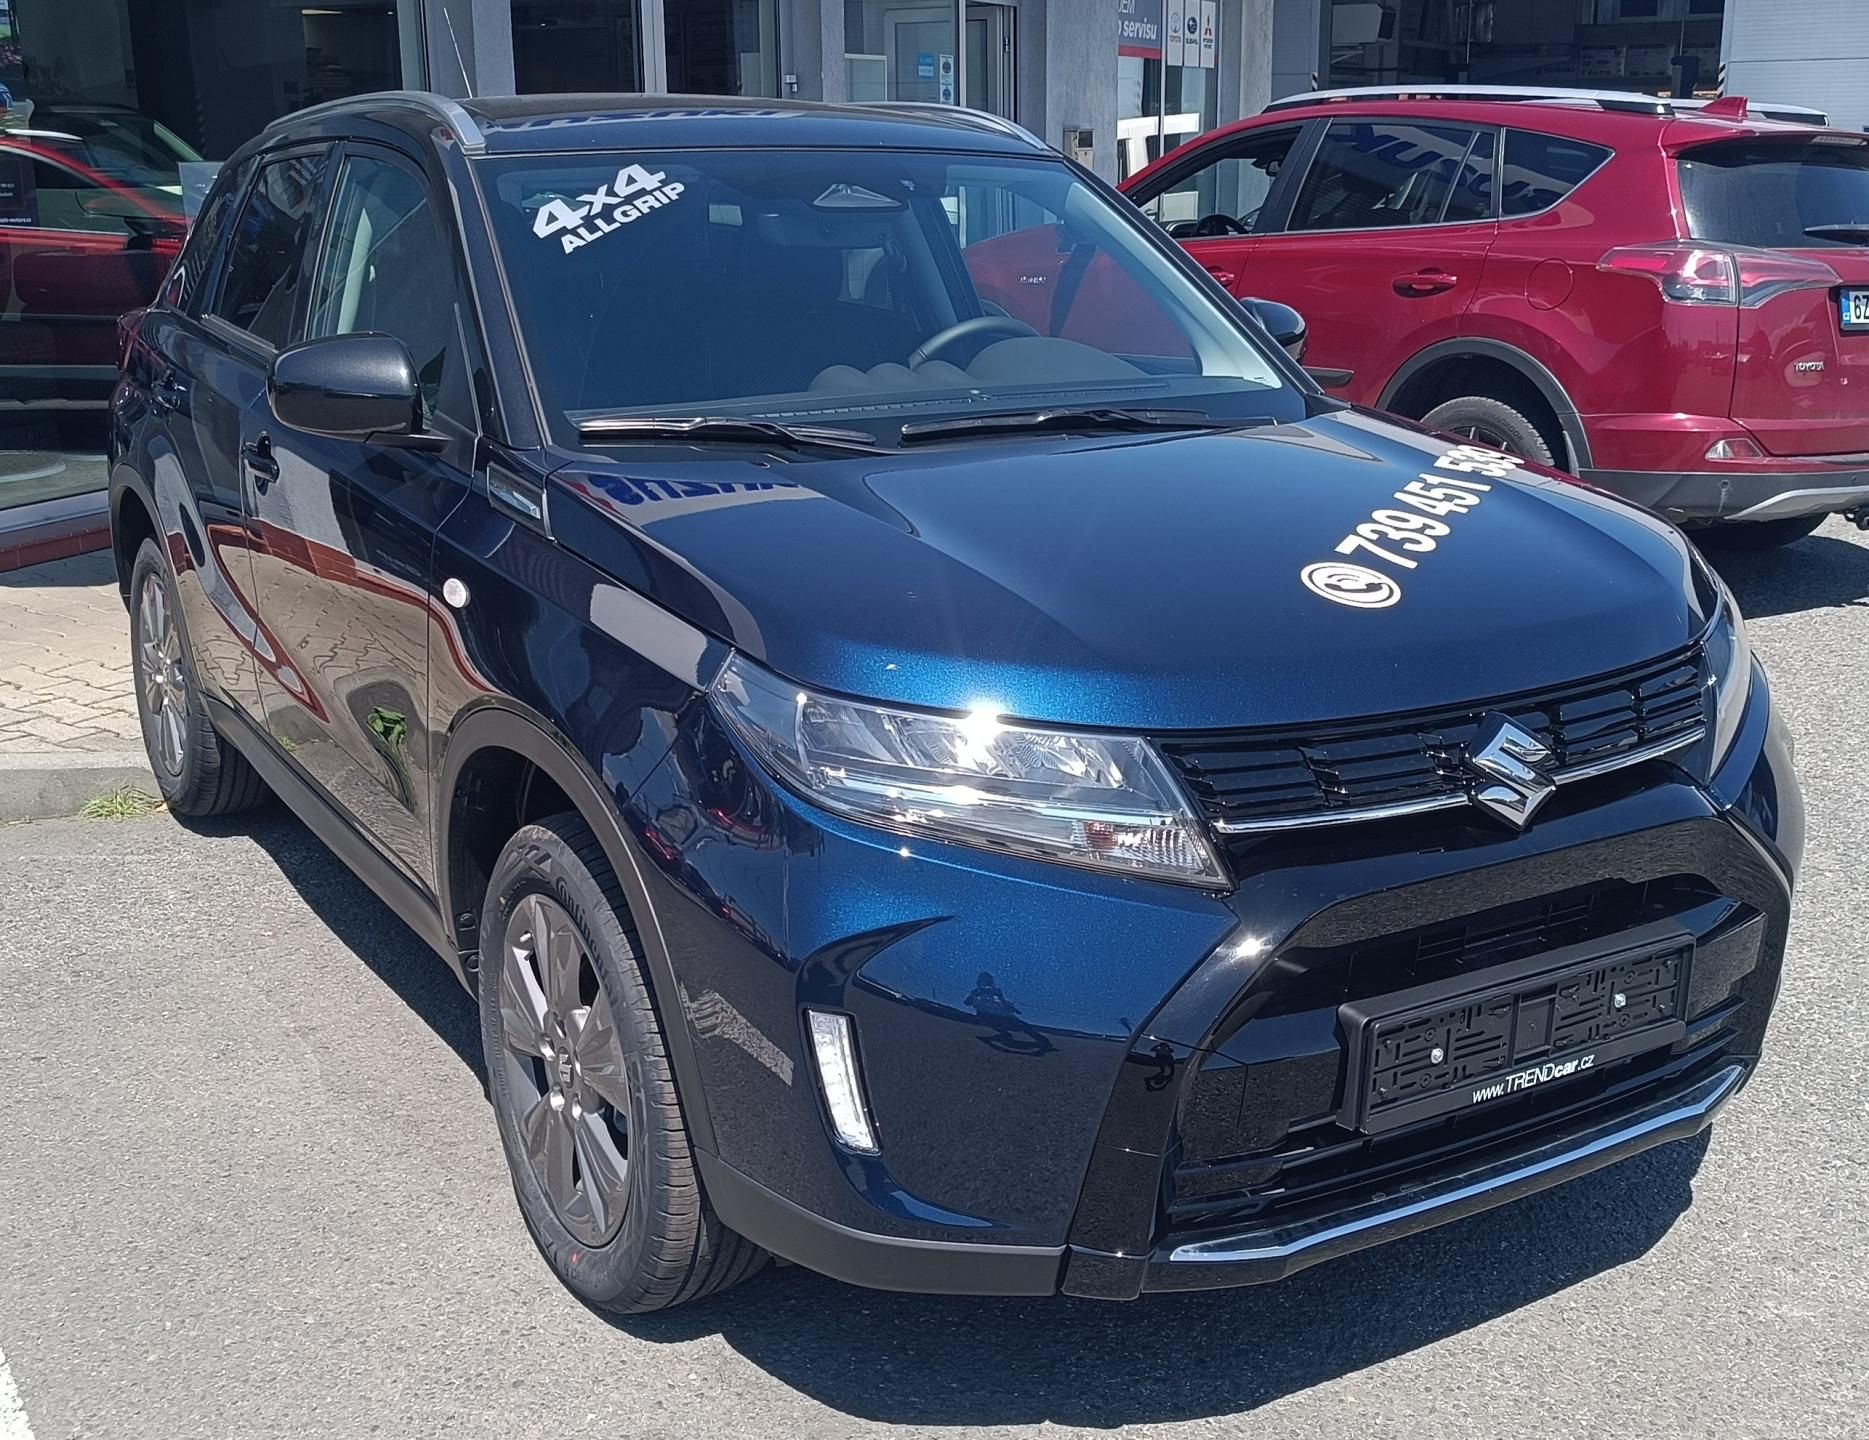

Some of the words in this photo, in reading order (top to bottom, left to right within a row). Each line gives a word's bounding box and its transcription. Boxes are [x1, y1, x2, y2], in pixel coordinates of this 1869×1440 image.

[1123, 16, 1157, 40] servisu
[533, 163, 666, 239] 4x4
[560, 182, 685, 255] ALLGRIP
[1333, 509, 1451, 570] 739
[1393, 472, 1492, 516] 451
[1472, 1054, 1595, 1104] www.TRENDcar.cz
